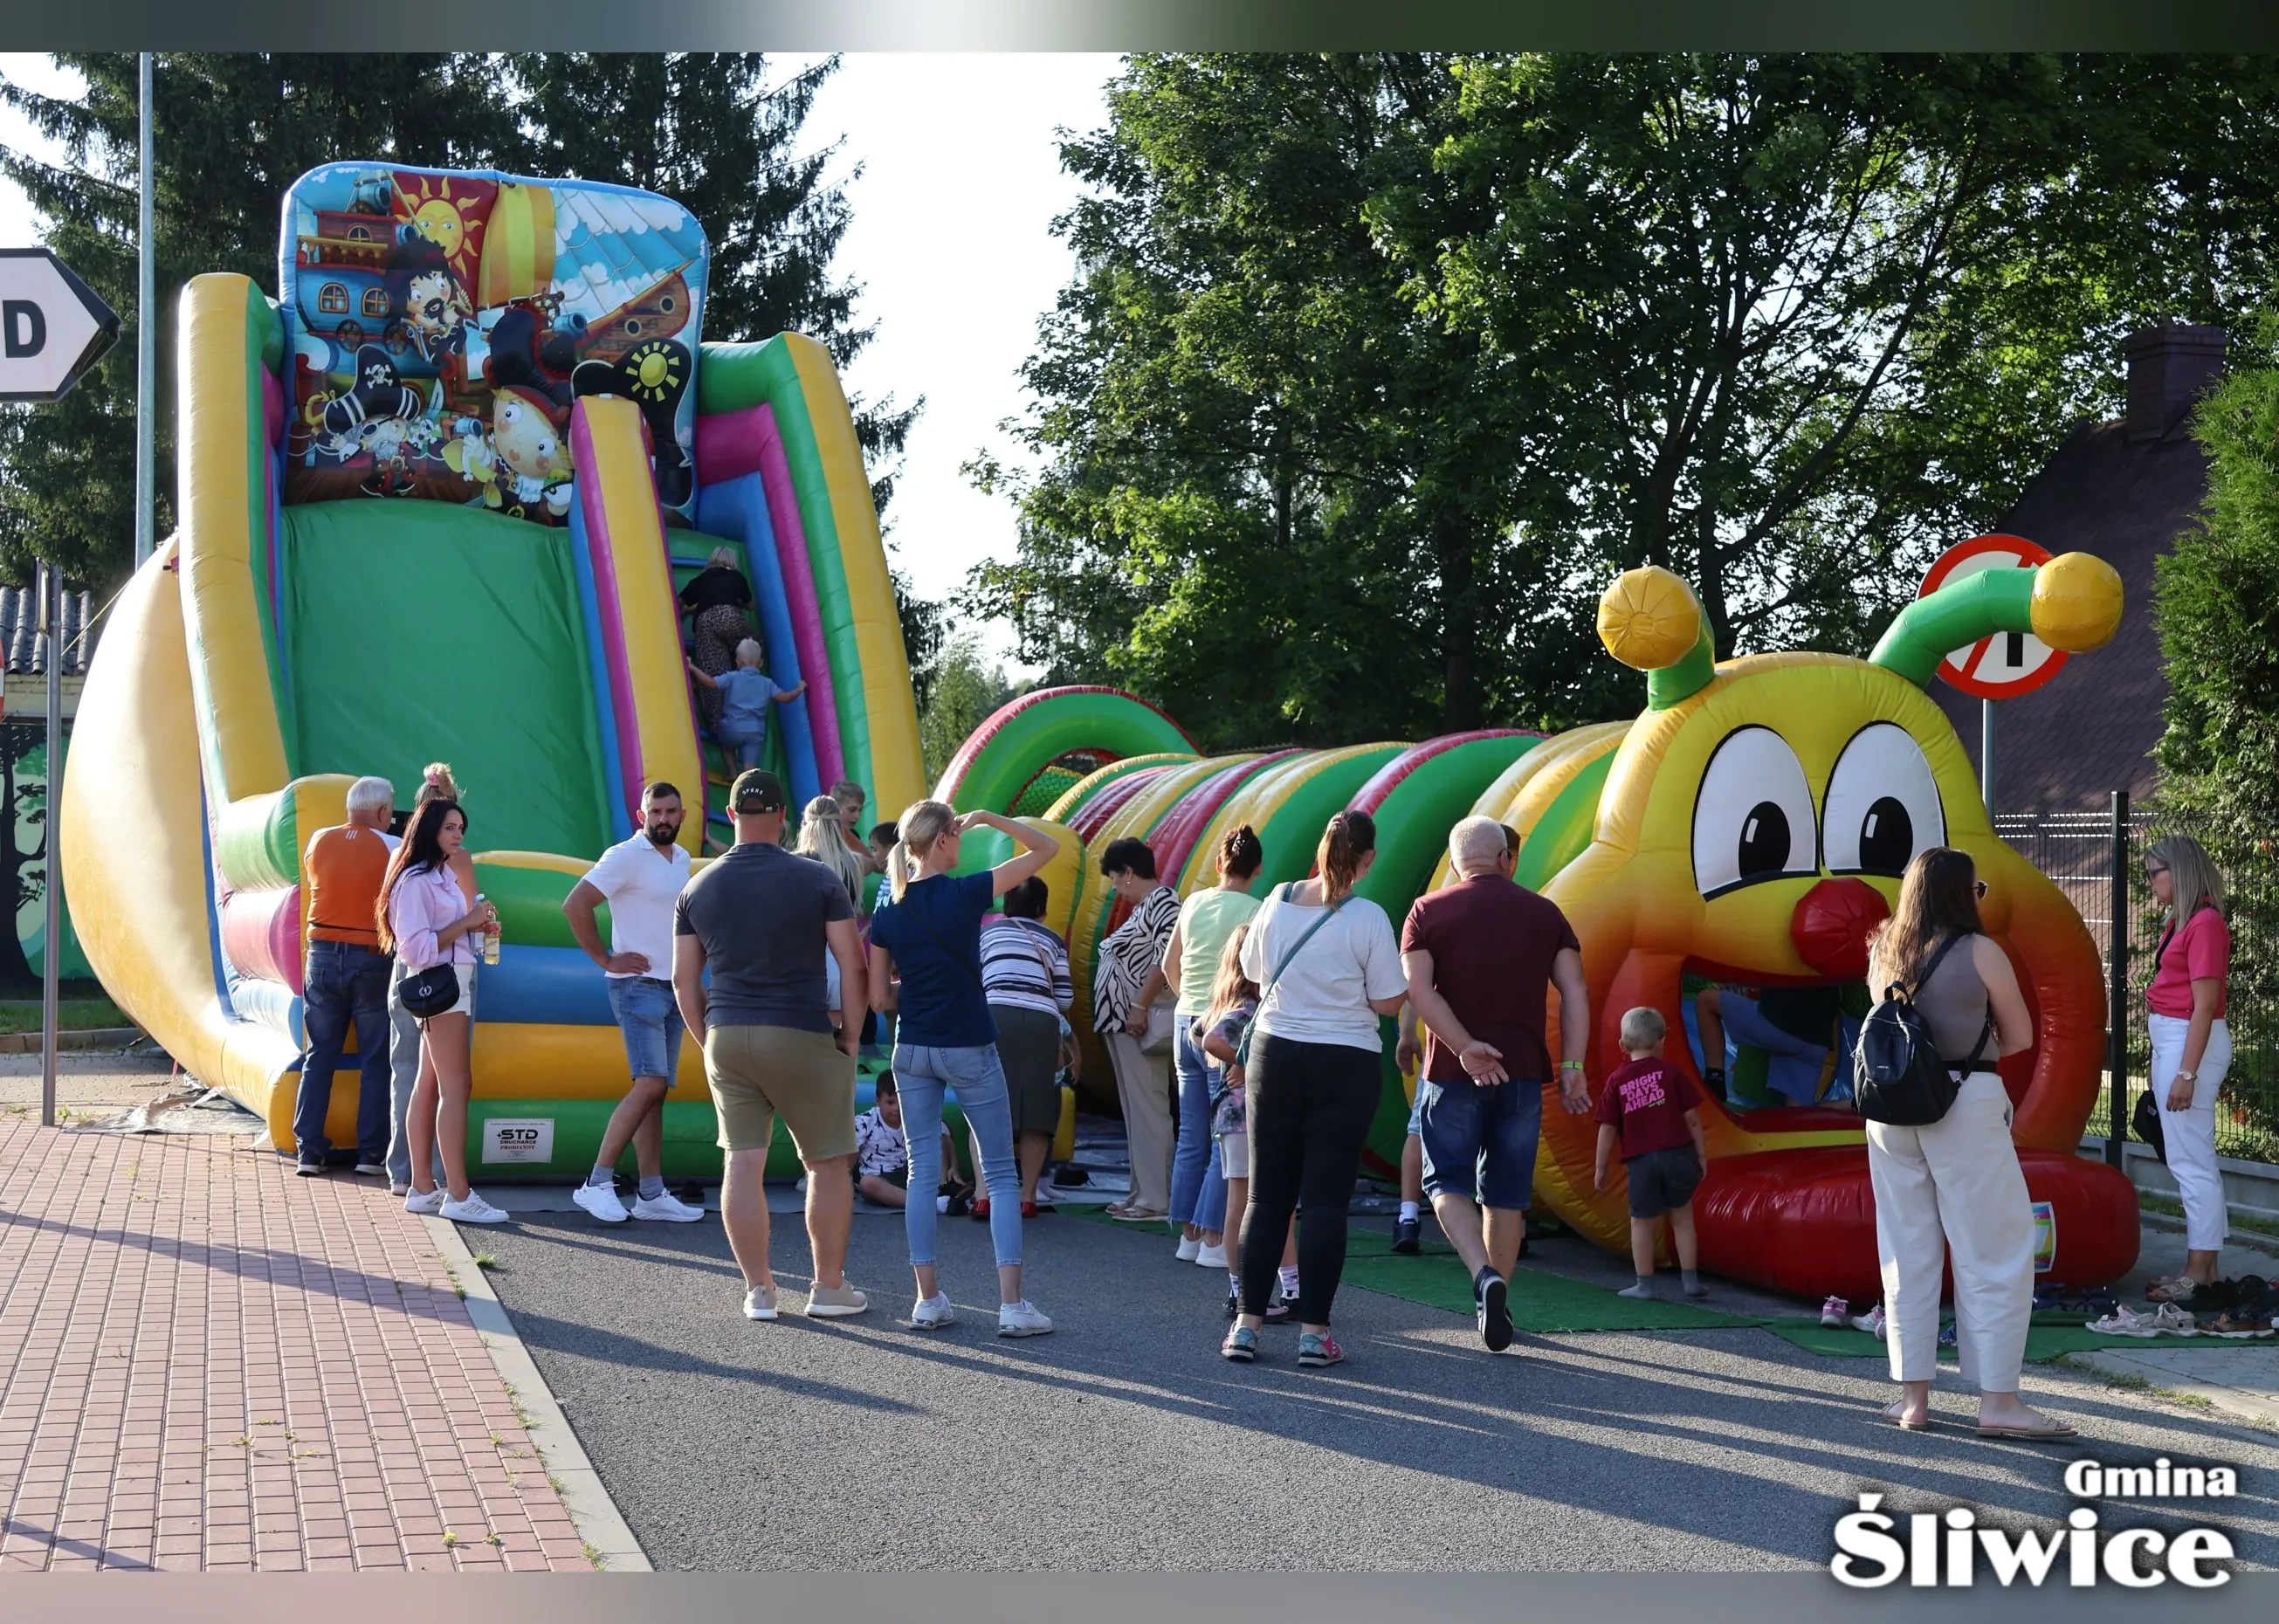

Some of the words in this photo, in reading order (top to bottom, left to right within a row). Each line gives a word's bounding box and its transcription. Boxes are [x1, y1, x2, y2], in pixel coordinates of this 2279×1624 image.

[3, 299, 46, 359] D
[1620, 1070, 1663, 1096] BRIGHT
[1627, 1081, 1659, 1102] DAYS
[1624, 1088, 1665, 1114] AHEAD
[500, 1129, 539, 1140] STD
